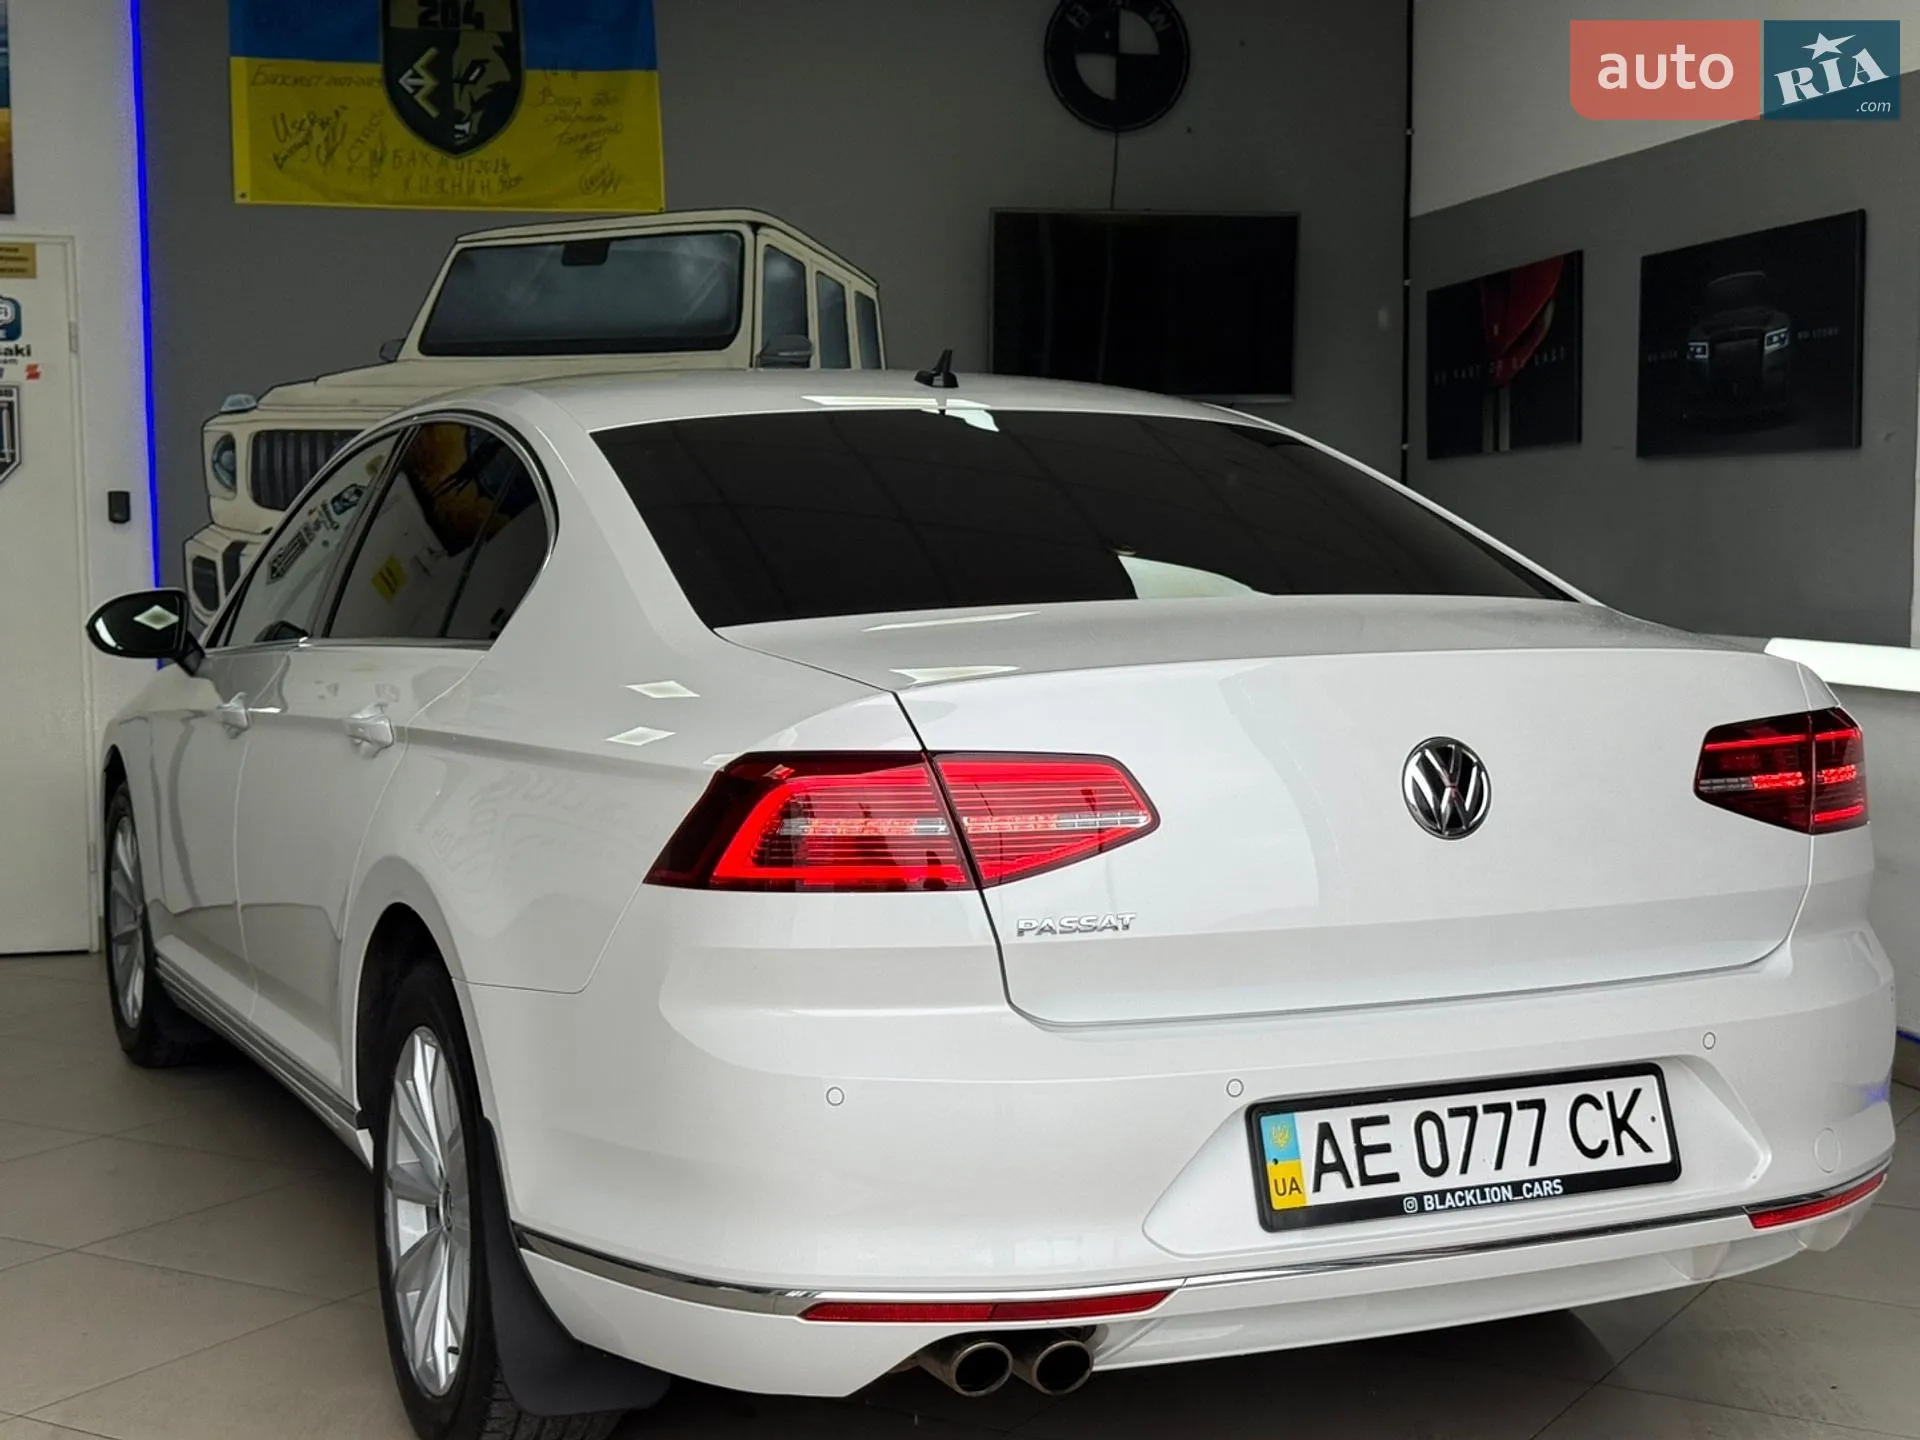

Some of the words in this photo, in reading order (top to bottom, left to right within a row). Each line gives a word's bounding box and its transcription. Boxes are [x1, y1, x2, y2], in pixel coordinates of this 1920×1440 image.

[418, 0, 484, 31] 204
[1016, 913, 1137, 937] PASSAT
[1312, 1114, 1400, 1193] AE
[1413, 1098, 1547, 1179] 0777
[1568, 1087, 1654, 1160] CK
[1274, 1175, 1302, 1197] UA
[1423, 1178, 1564, 1211] BLACKLION_CARS
